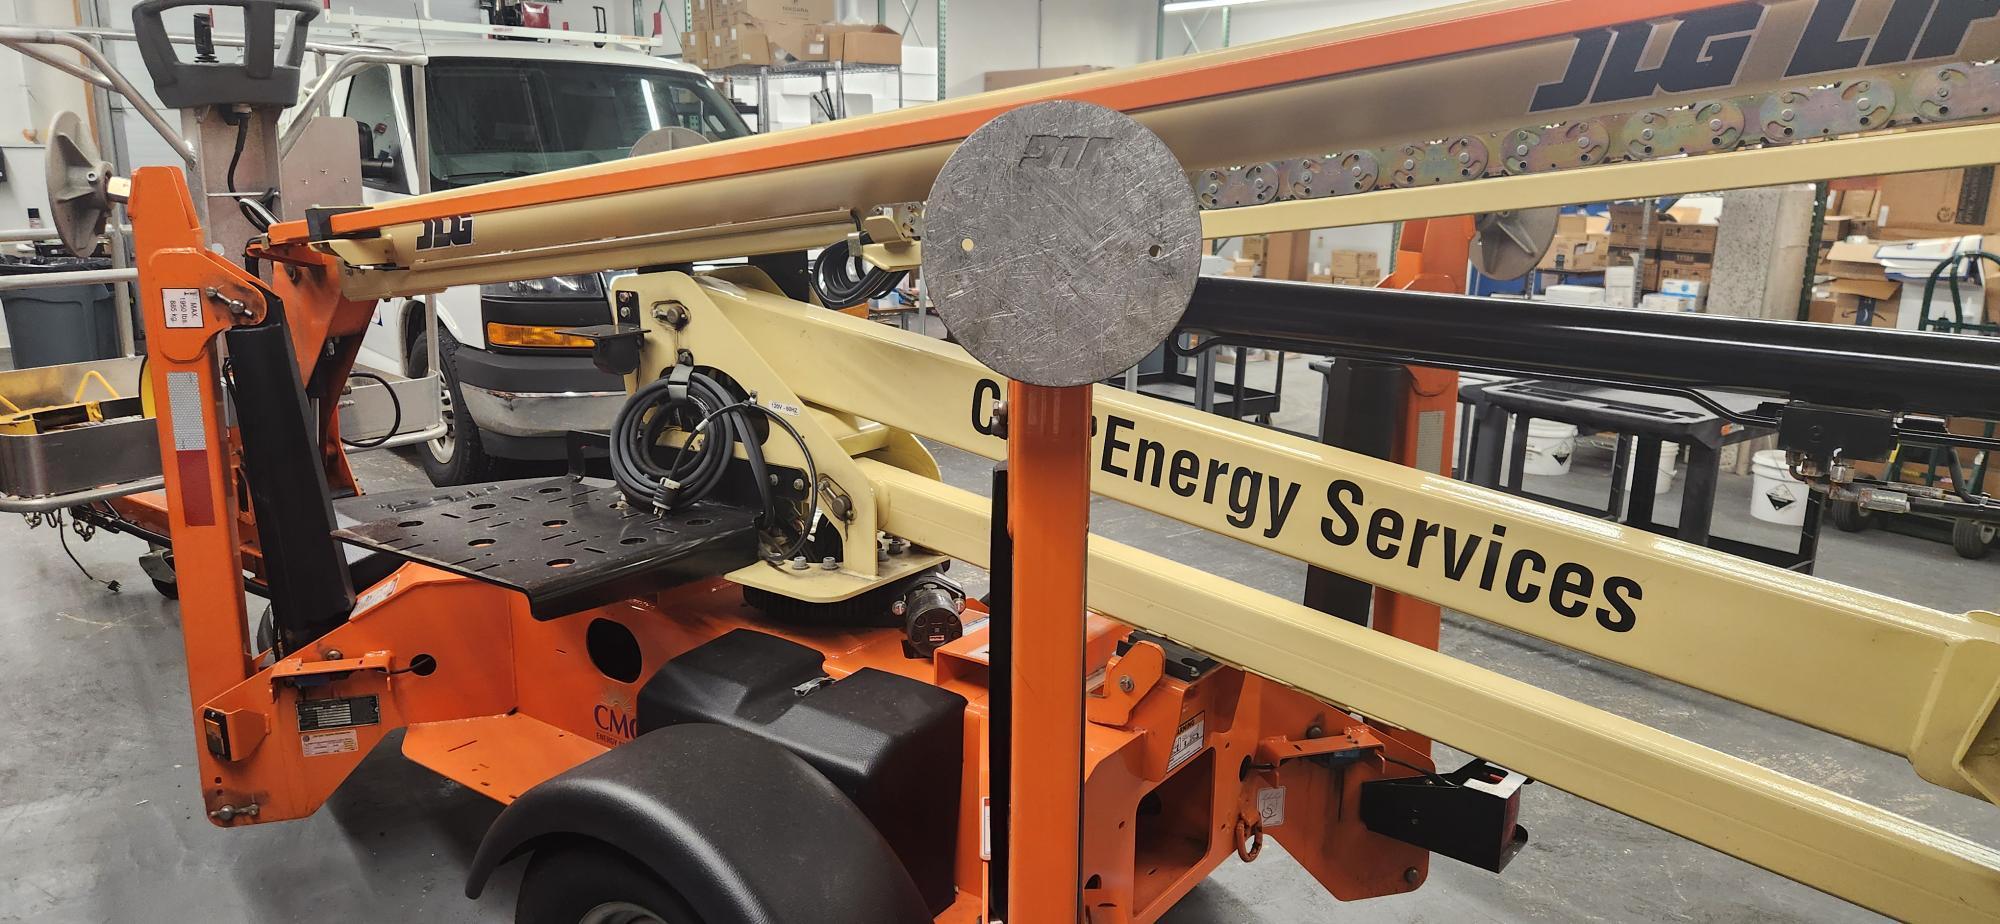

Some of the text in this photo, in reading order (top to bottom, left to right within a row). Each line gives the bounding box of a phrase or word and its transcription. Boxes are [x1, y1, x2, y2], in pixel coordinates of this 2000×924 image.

[1529, 0, 1770, 112] JLG
[416, 213, 474, 251] JLG
[1101, 415, 1643, 633] Energy Services
